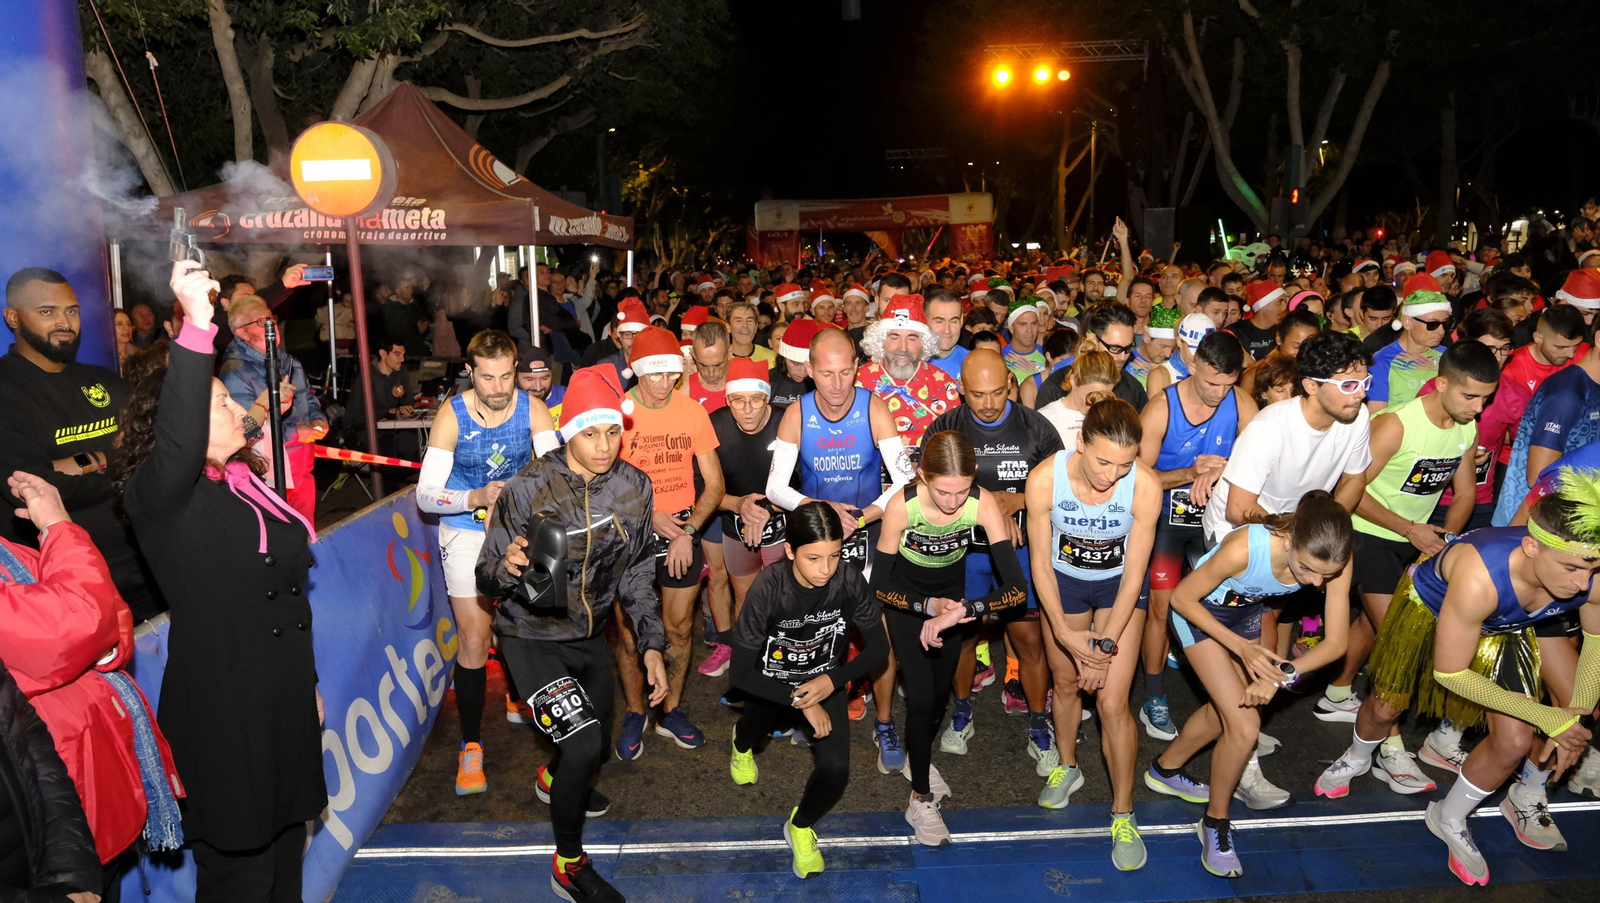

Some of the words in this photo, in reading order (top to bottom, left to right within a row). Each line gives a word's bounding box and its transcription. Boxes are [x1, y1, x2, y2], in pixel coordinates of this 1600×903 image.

[304, 230, 385, 241] cronomtraje
[388, 230, 446, 241] deportivo
[586, 413, 616, 422] cajamar
[846, 418, 866, 427] SPIRAL
[665, 433, 692, 451] Cortijo
[817, 435, 856, 449] GALO
[654, 452, 664, 464] del
[666, 452, 682, 463] Fraile
[814, 452, 862, 472] RODRÍGUEZ
[997, 460, 1028, 468] STAR
[997, 470, 1028, 478] WARS
[1422, 472, 1450, 483] 1382
[655, 481, 688, 494] EXCUSAS
[1063, 515, 1121, 530] nerja
[920, 543, 959, 552] 1033
[1072, 548, 1112, 560] 1437
[787, 651, 816, 661] 651
[551, 694, 582, 717] 610
